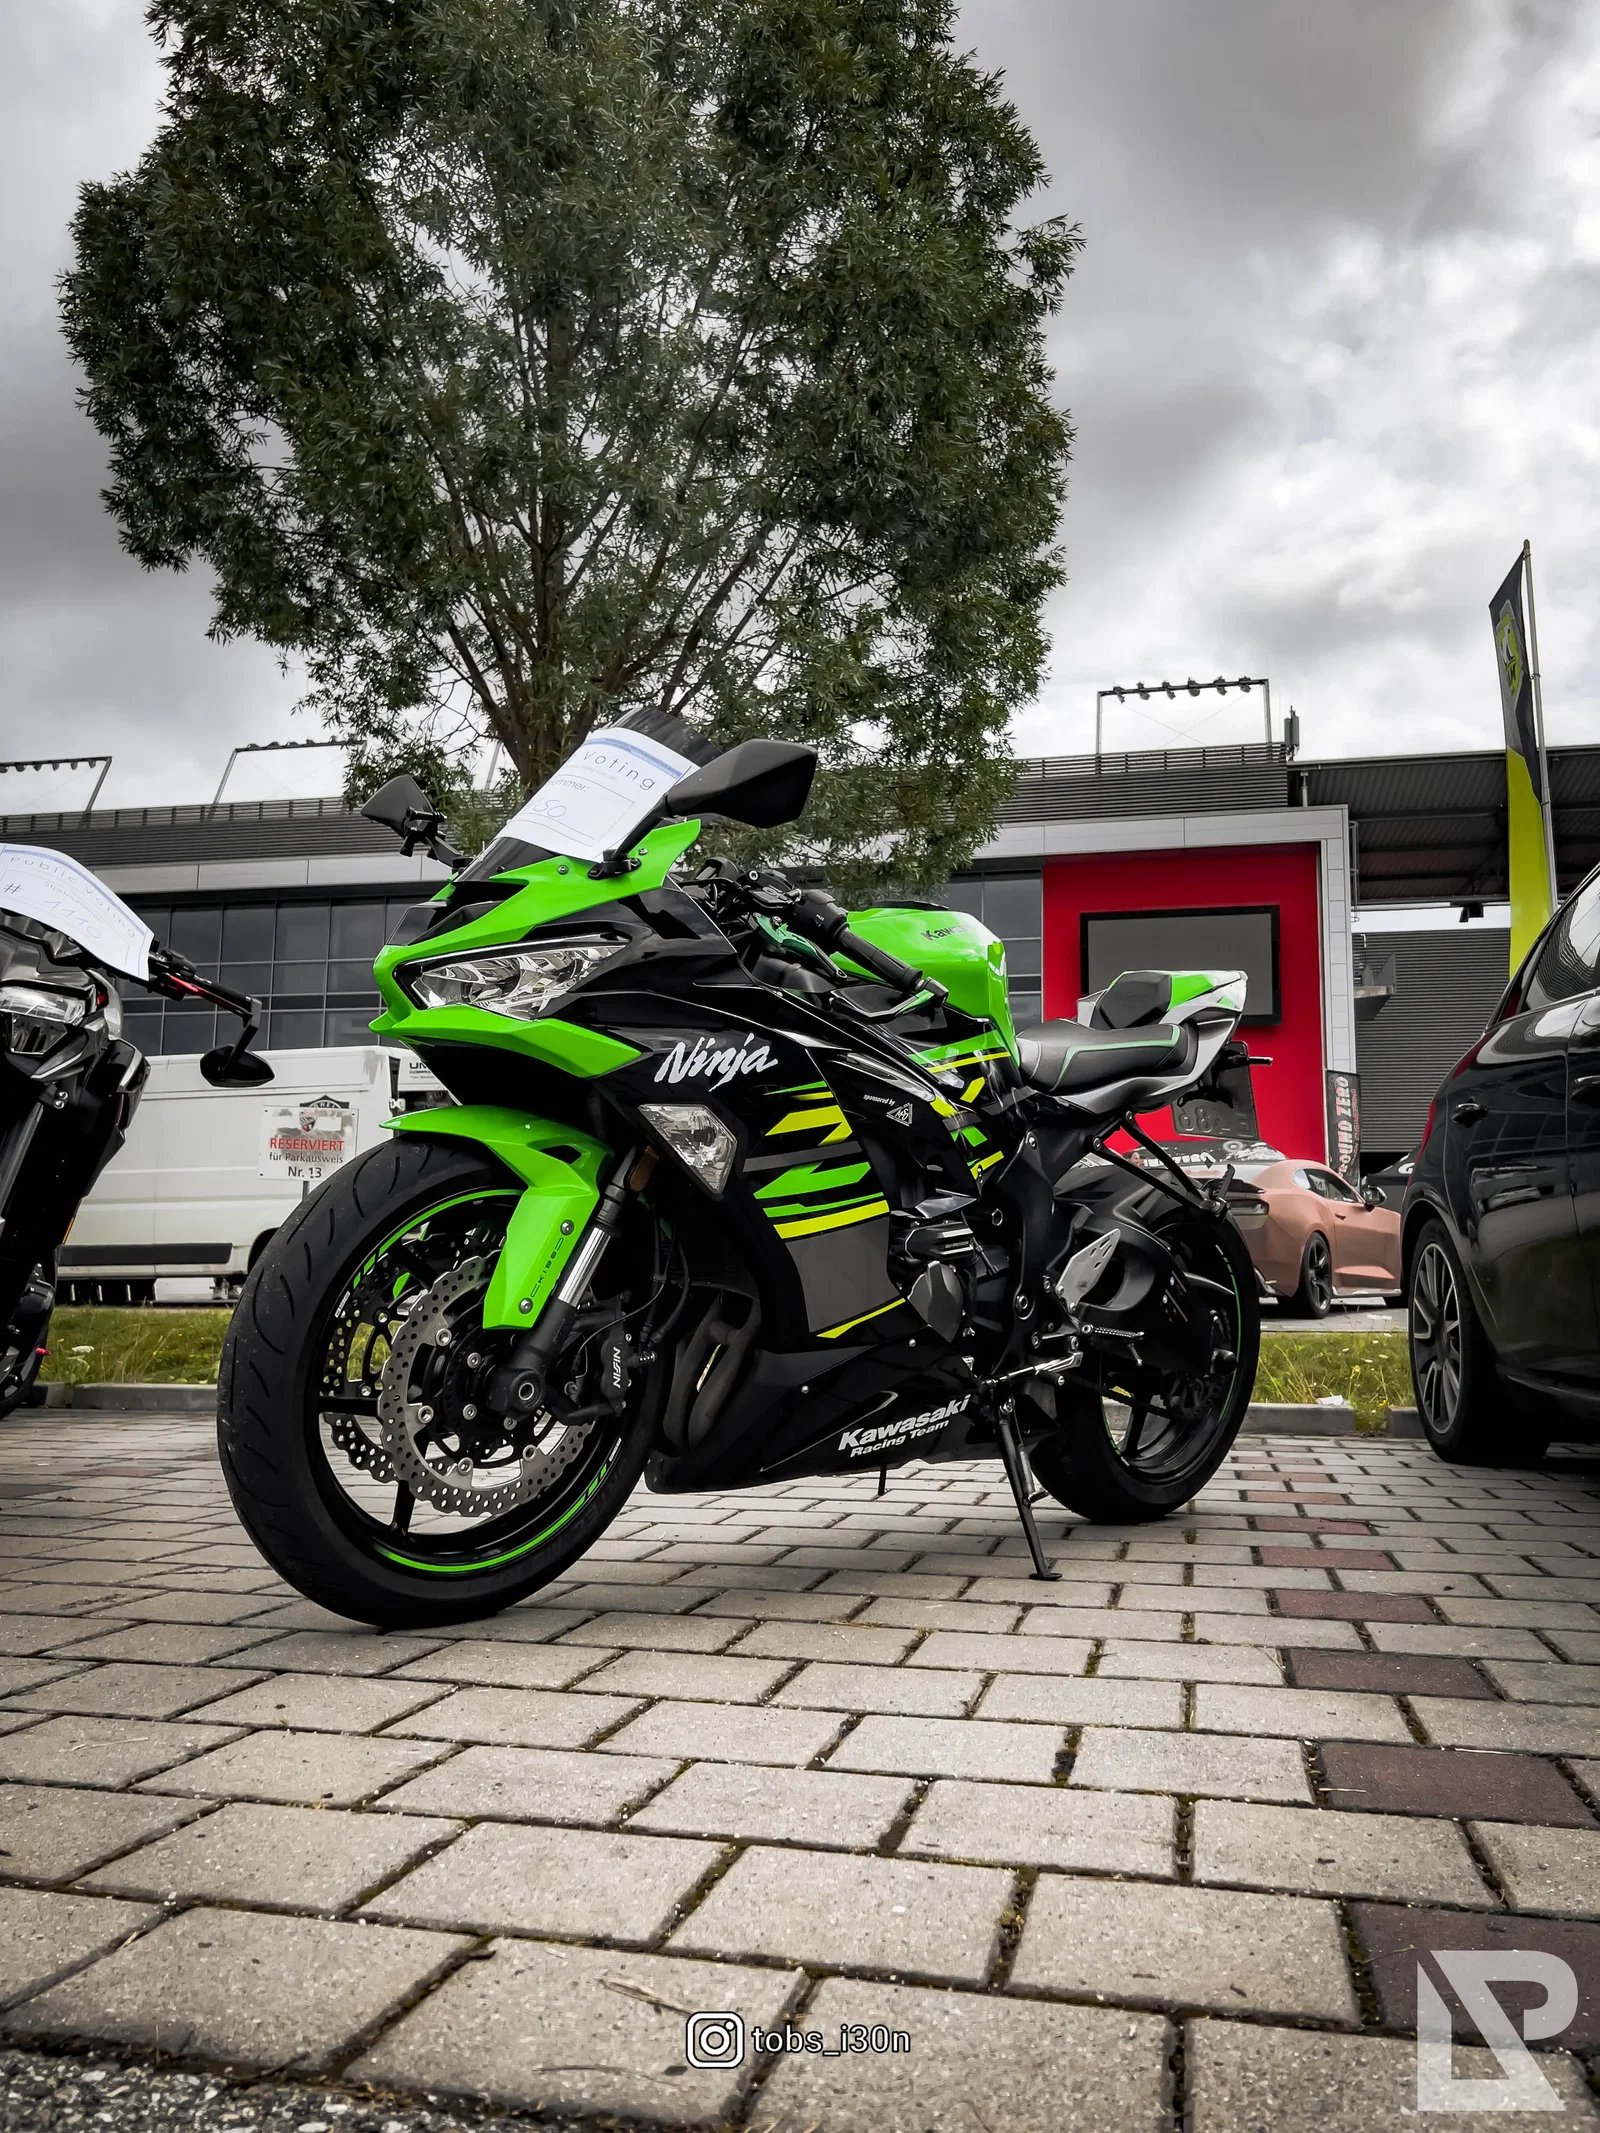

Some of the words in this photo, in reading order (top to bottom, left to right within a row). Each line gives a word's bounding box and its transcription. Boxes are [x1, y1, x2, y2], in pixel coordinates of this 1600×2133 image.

[654, 1033, 778, 1092] Ninja
[1335, 1076, 1352, 1117] ZERO
[269, 1138, 345, 1151] RESERVIERT
[269, 1152, 282, 1161] für
[285, 1153, 344, 1164] Parkausweis
[288, 1166, 304, 1178] Nr.
[308, 1167, 322, 1179] 13
[838, 1394, 972, 1451] Kawasaki
[850, 1434, 906, 1458] Racing
[910, 1419, 950, 1439] Team
